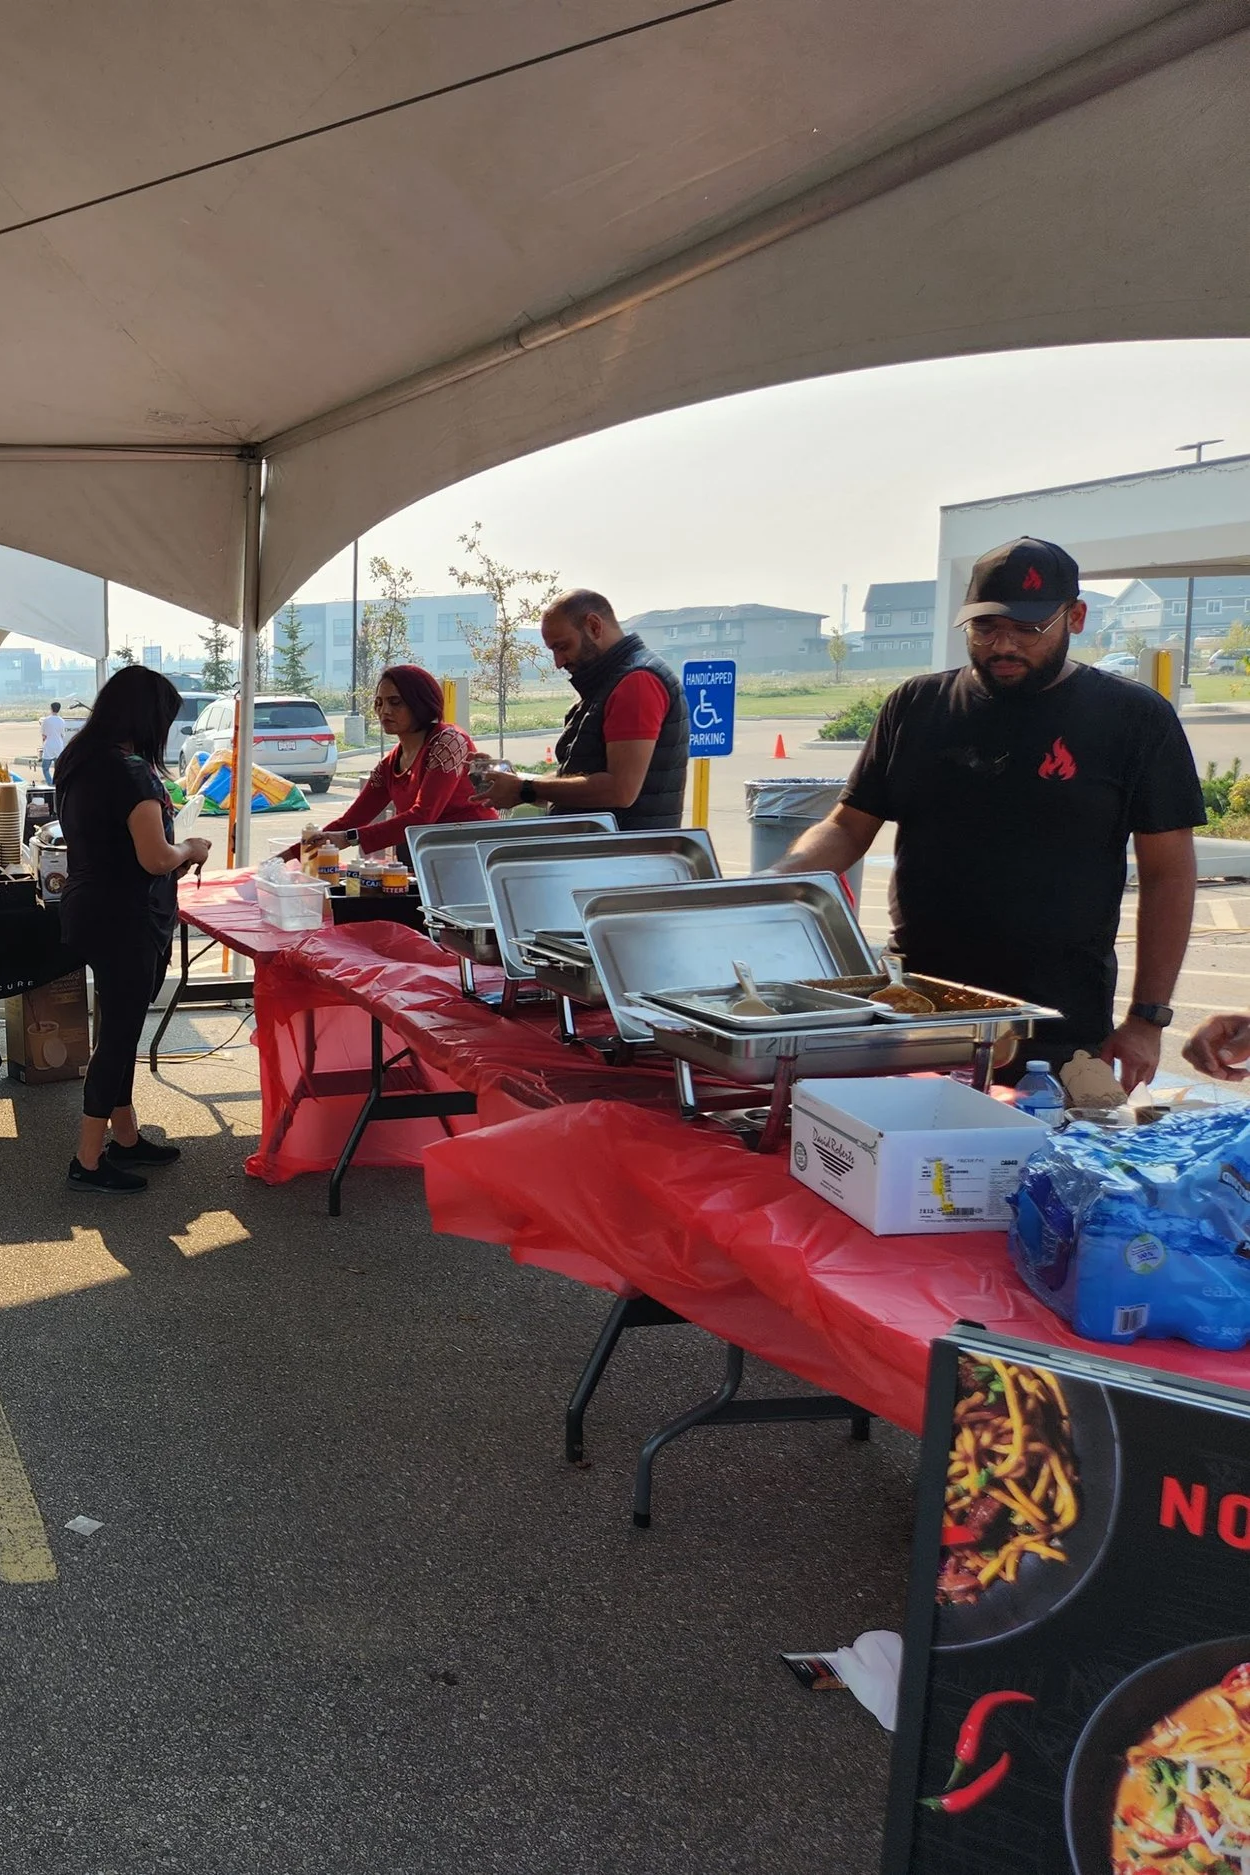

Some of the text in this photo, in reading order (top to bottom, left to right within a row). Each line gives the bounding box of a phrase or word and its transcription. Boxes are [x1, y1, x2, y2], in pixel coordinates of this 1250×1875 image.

[685, 672, 733, 686] HANDICAPPED
[688, 732, 726, 746] PARKING
[812, 1126, 830, 1149] David
[831, 1138, 855, 1164] Roberts
